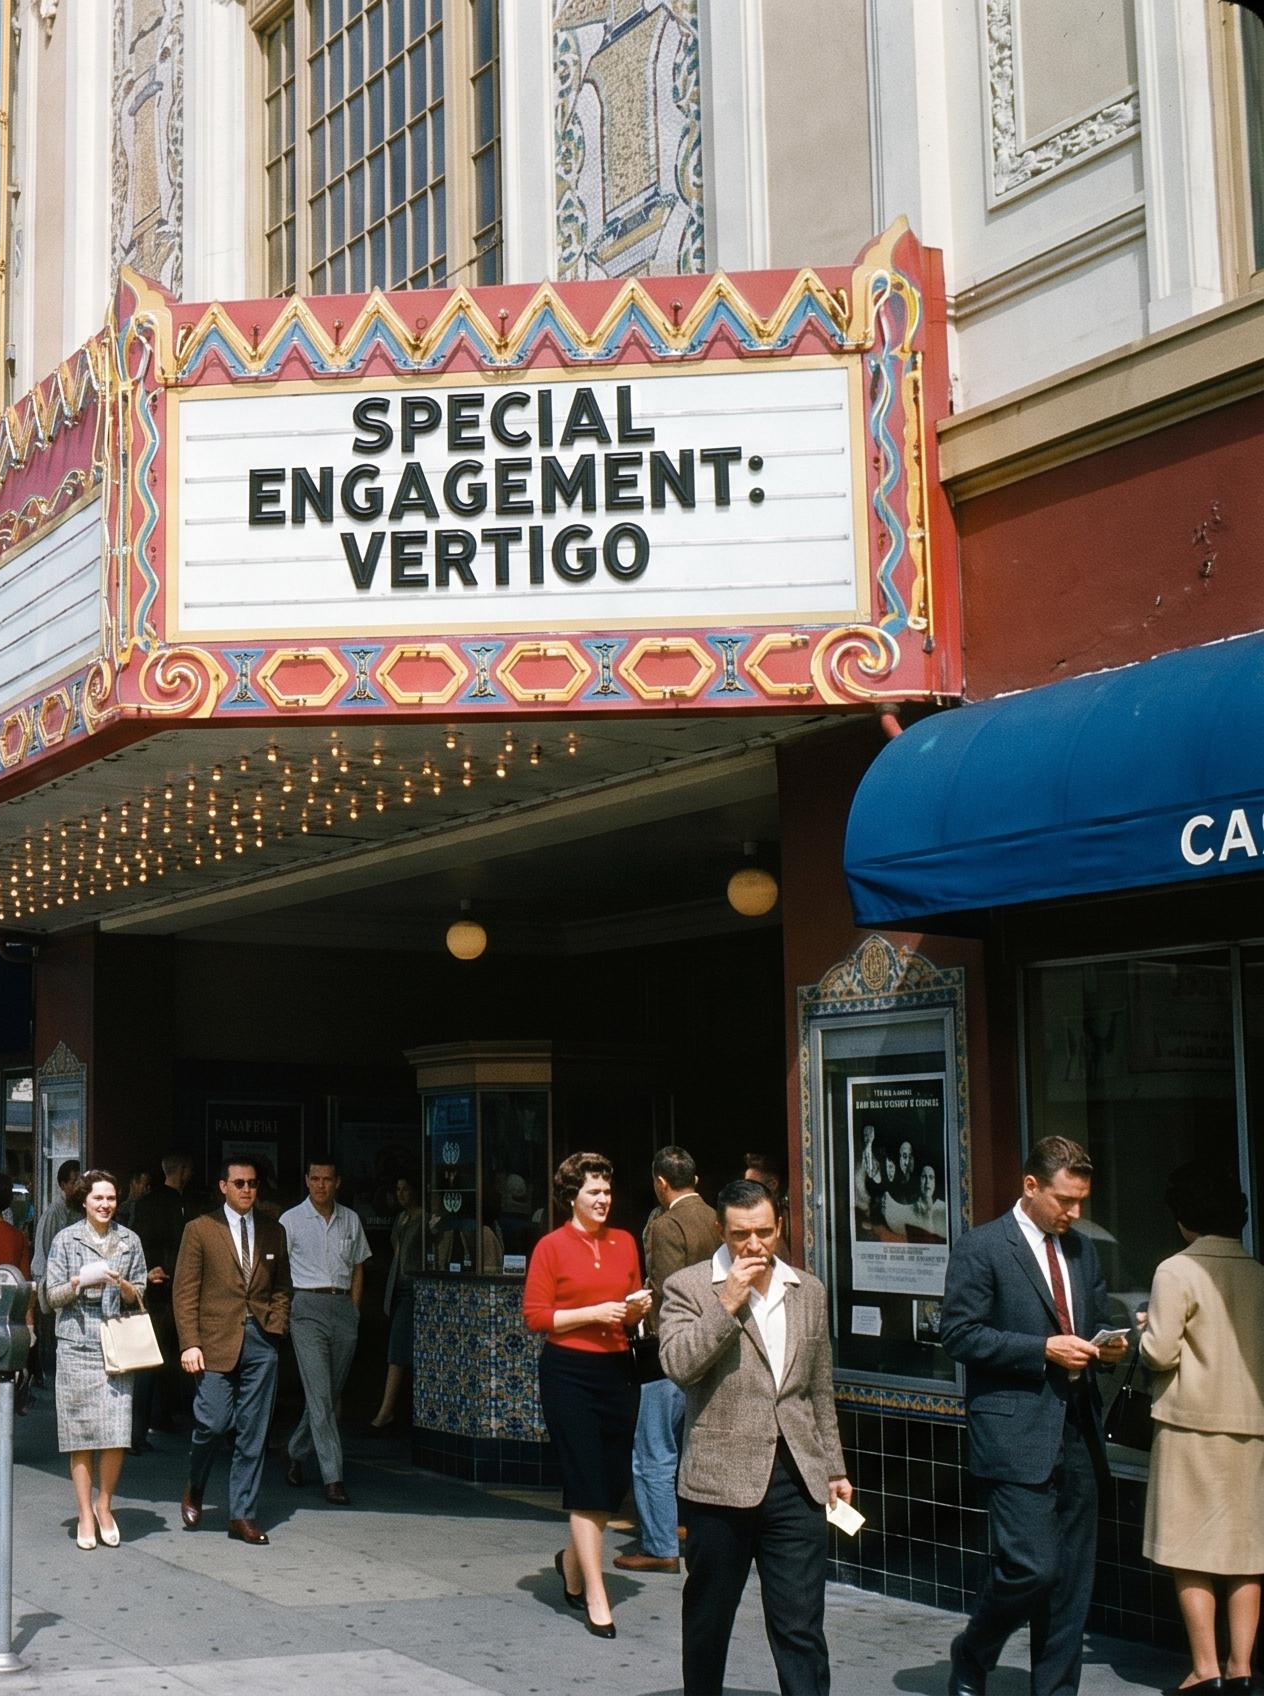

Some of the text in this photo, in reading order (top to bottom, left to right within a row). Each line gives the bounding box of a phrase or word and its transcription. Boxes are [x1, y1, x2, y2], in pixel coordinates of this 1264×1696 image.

[352, 384, 655, 454] SPECIAL
[249, 445, 765, 526] ENGAGEMENT:
[340, 521, 650, 589] VERTIGO
[1180, 808, 1264, 866] CA
